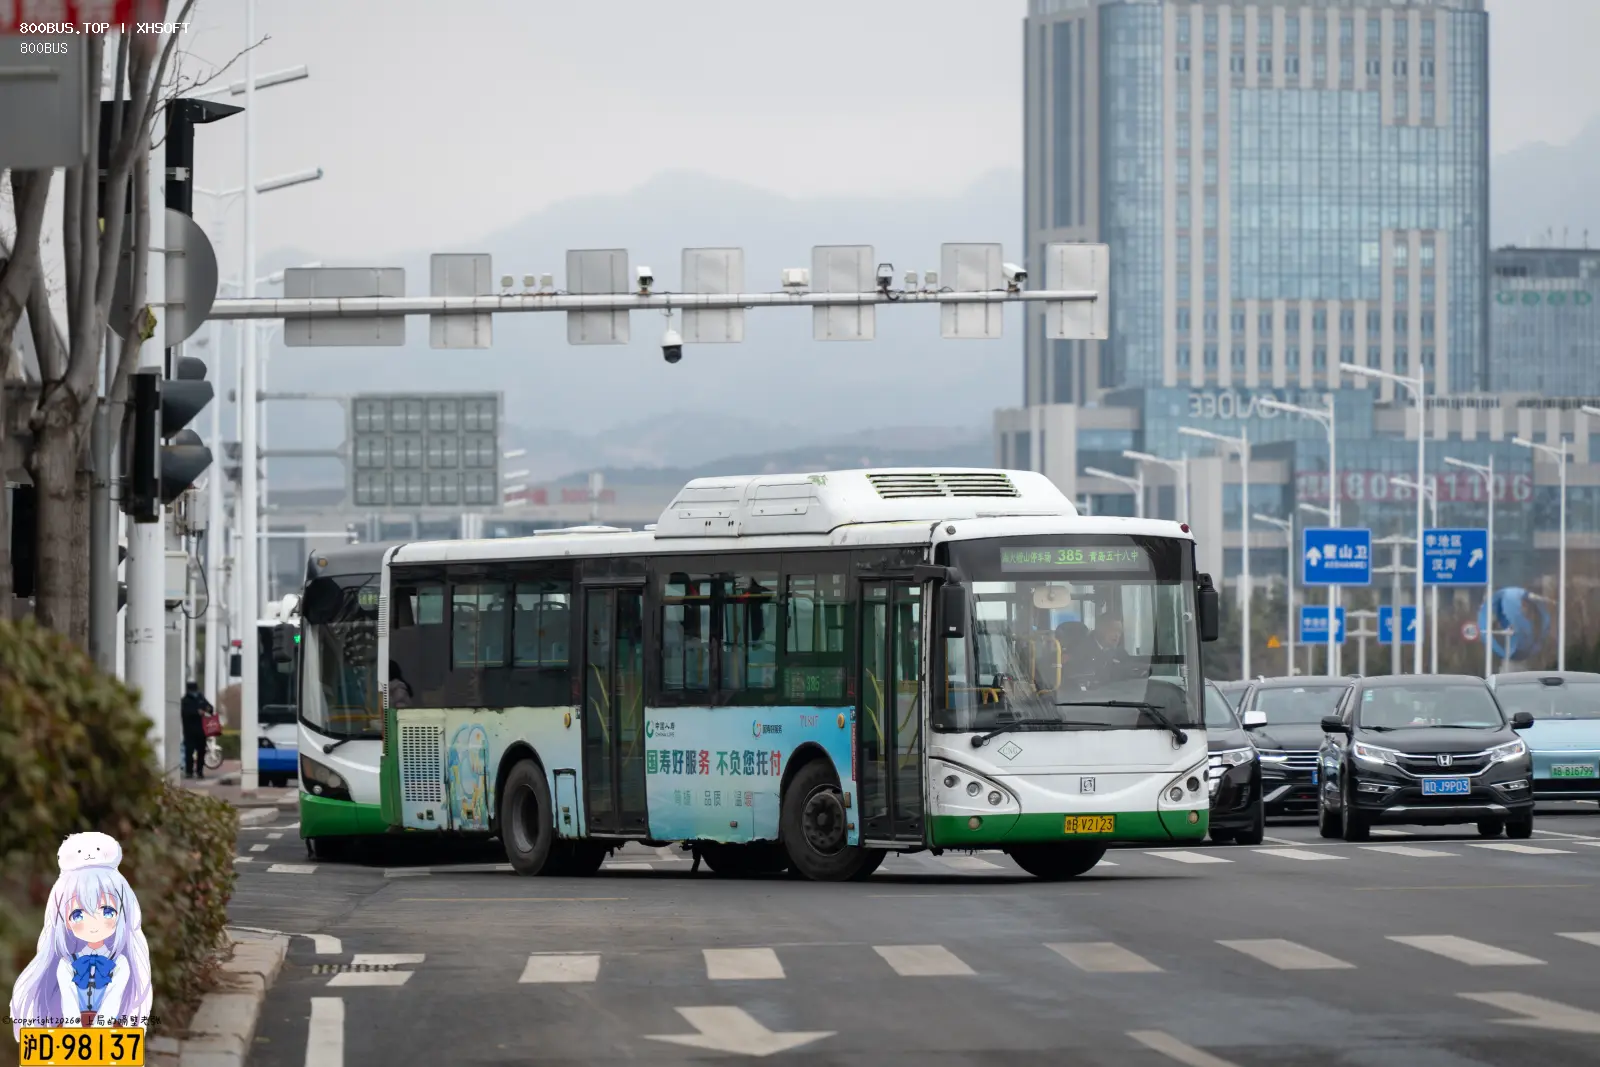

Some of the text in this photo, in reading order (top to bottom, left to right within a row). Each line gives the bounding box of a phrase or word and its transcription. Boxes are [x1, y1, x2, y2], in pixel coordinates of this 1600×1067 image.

[1058, 550, 1083, 562] 385
[646, 749, 781, 776] 国寿好服务 不负您托付
